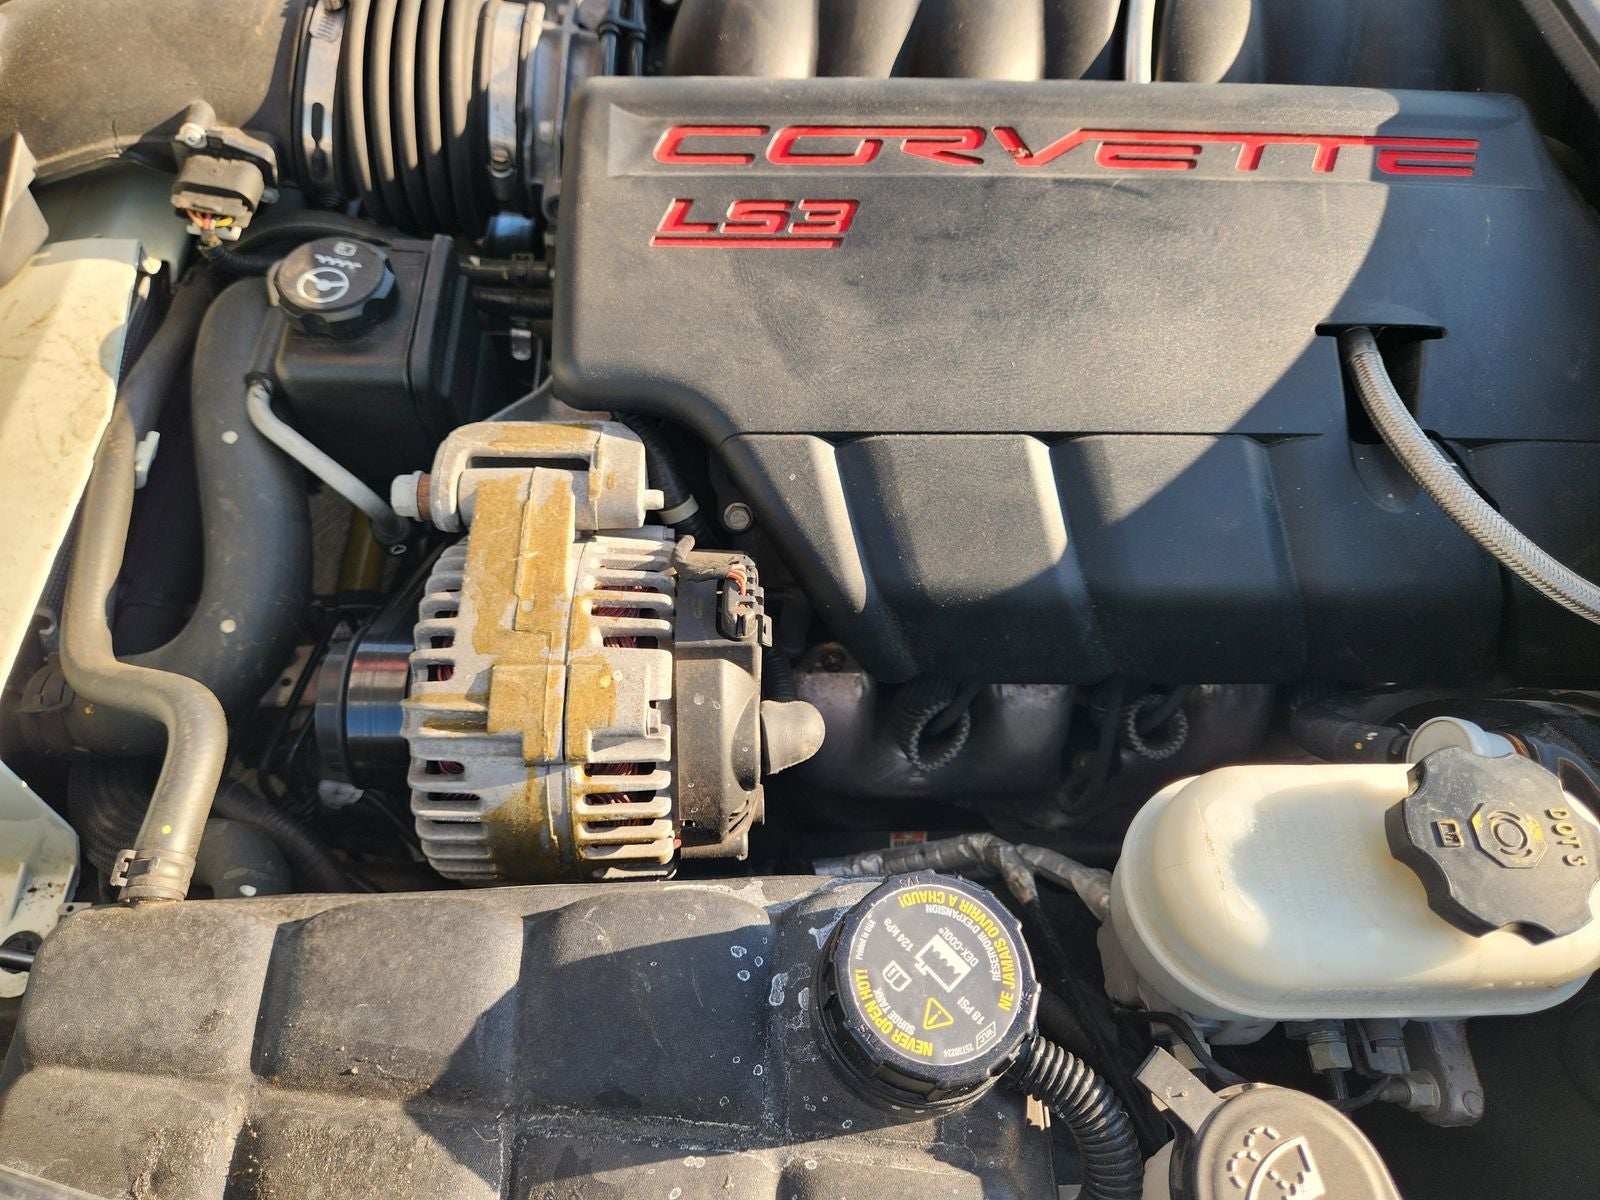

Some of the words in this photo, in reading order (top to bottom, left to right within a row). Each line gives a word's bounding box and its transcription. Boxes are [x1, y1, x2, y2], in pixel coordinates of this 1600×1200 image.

[652, 125, 1480, 176] CORVETTE
[655, 198, 860, 234] LS3
[1549, 807, 1582, 849] DOT
[1563, 853, 1589, 867] 3
[897, 890, 946, 908] CHAUD!
[948, 894, 958, 907] A
[884, 917, 901, 937] kPa
[925, 904, 980, 934] D'EXPANSION
[959, 899, 1000, 938] OUVRIR
[896, 933, 913, 951] 124
[994, 938, 1016, 989] JAMAIS
[855, 969, 874, 1001] HOT!
[873, 987, 891, 1014] TANK
[957, 996, 975, 1014] PSI
[998, 990, 1014, 1011] NE
[864, 1000, 894, 1035] OPEN
[887, 1010, 916, 1036] SURGE
[971, 1010, 985, 1025] 18
[890, 1028, 933, 1057] NEVER
